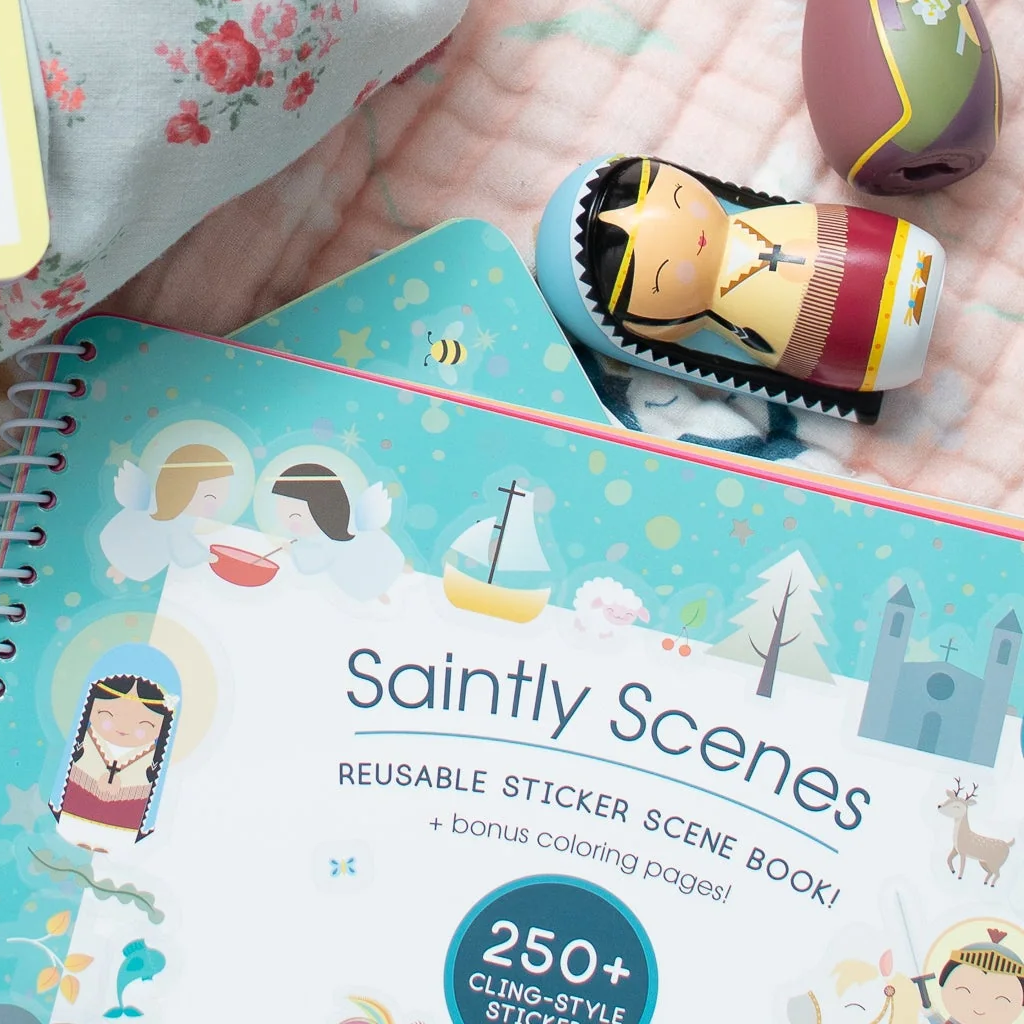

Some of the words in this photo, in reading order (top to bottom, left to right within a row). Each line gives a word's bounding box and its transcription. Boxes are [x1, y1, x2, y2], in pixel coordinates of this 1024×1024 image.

[347, 648, 591, 740] Saintly
[610, 682, 871, 831] Scenes
[339, 762, 487, 793] REUSABLE
[502, 775, 628, 823] STICKER
[643, 809, 738, 860] SCENE
[745, 846, 841, 909] BOOK!
[429, 817, 443, 831] +
[452, 813, 529, 844] bonus
[537, 831, 639, 875] coloring
[643, 860, 732, 904] pages!
[482, 919, 631, 985] 250+
[469, 972, 626, 1024] CLING-STYLE
